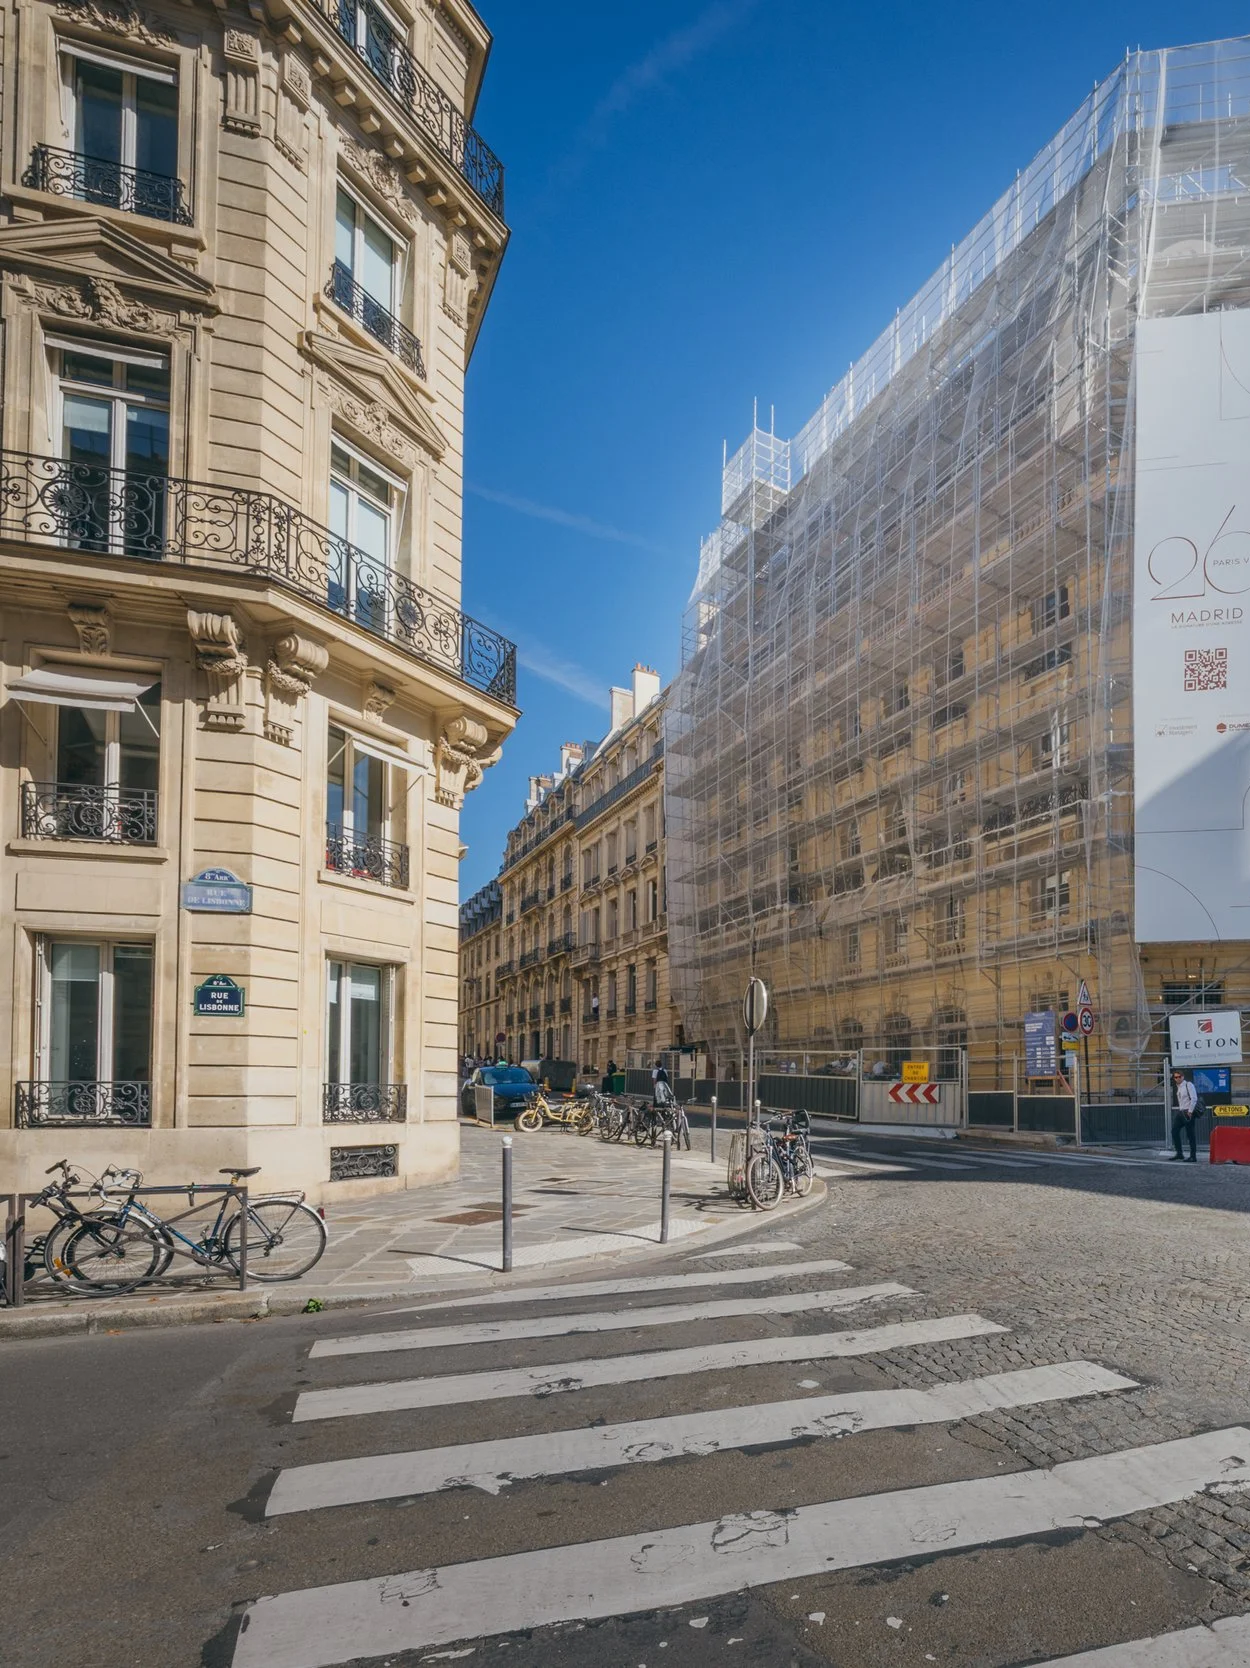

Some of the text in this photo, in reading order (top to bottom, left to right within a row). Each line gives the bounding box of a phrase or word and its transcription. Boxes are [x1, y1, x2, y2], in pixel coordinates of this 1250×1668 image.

[1213, 558, 1240, 566] PARIS
[1171, 607, 1243, 623] MADRID
[207, 889, 225, 897] RUE
[188, 896, 246, 906] DE LISBONNE
[1082, 1014, 1092, 1028] 30
[1174, 1038, 1239, 1050] TECTON
